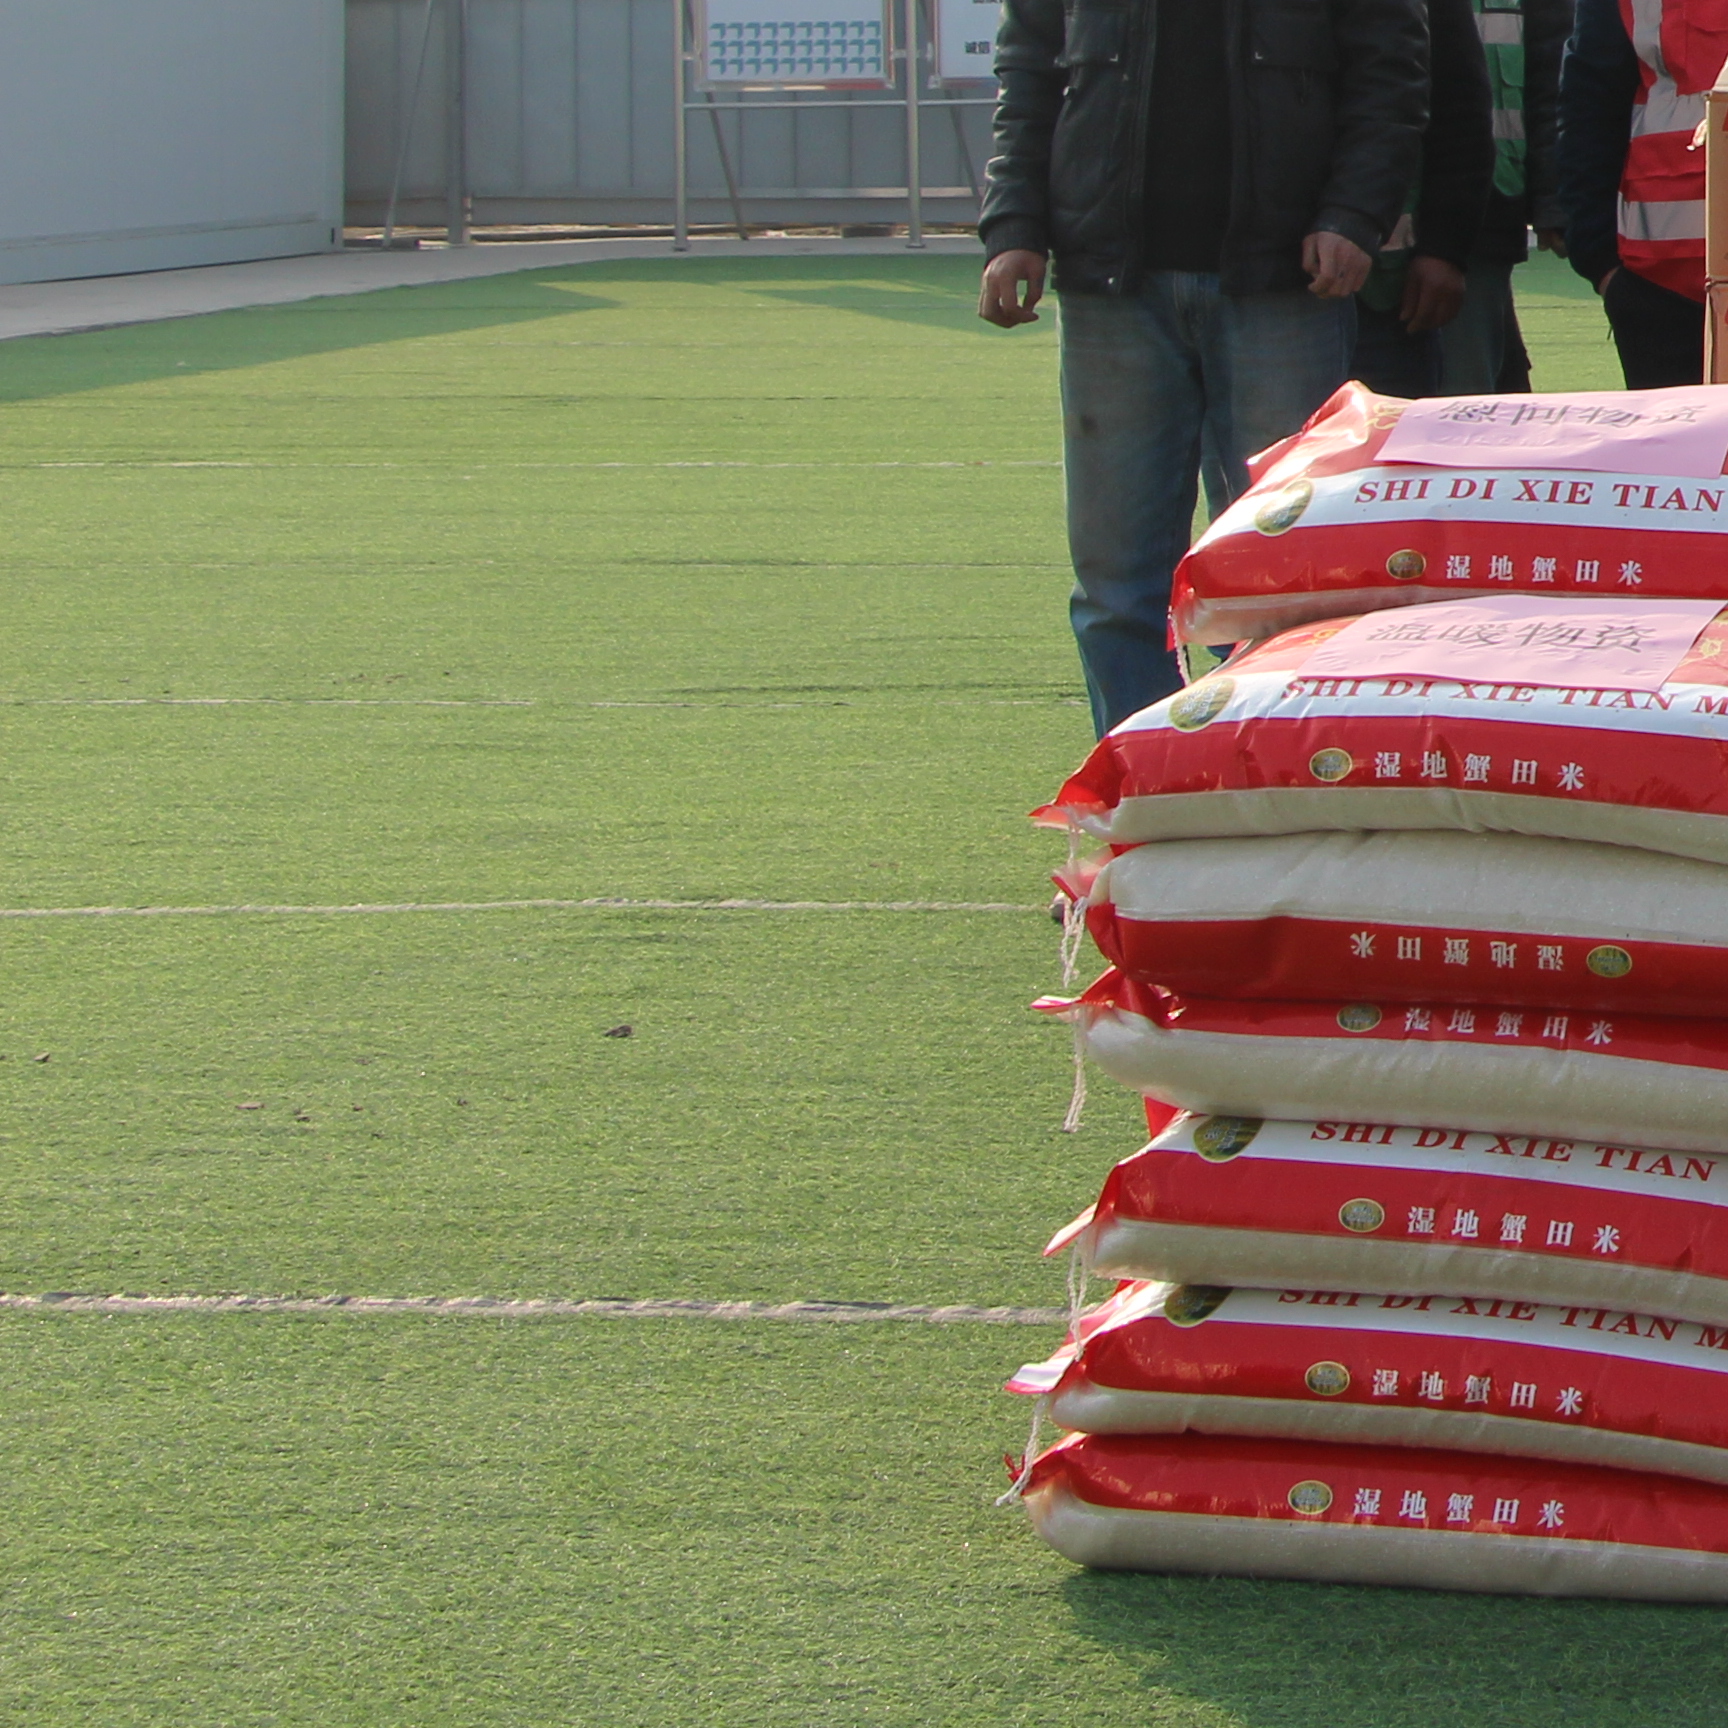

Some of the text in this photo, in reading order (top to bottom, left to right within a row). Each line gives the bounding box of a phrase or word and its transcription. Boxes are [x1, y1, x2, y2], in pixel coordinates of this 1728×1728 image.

[1355, 478, 1431, 504] SHI
[1446, 478, 1498, 500] DI
[1513, 479, 1594, 505] XIE
[1612, 483, 1725, 512] TIAN
[1446, 554, 1644, 586] 湿地蟹田米
[1366, 622, 1654, 653] 温暖物资
[1280, 676, 1367, 700] SHI
[1376, 680, 1436, 698] DI
[1446, 683, 1539, 704] XIE
[1556, 688, 1677, 712] TIAN
[1374, 751, 1584, 790] 湿地蟹田米
[1404, 1008, 1613, 1045] 湿地蟹田米
[1310, 1121, 1396, 1145] SHI
[1413, 1129, 1467, 1150] DI
[1485, 1135, 1574, 1162] XIE
[1593, 1145, 1719, 1183] TIAN
[1407, 1206, 1620, 1254] 湿地蟹田米
[1372, 1368, 1583, 1416] 湿地蟹田米
[1353, 1489, 1565, 1528] 湿地蟹田米
